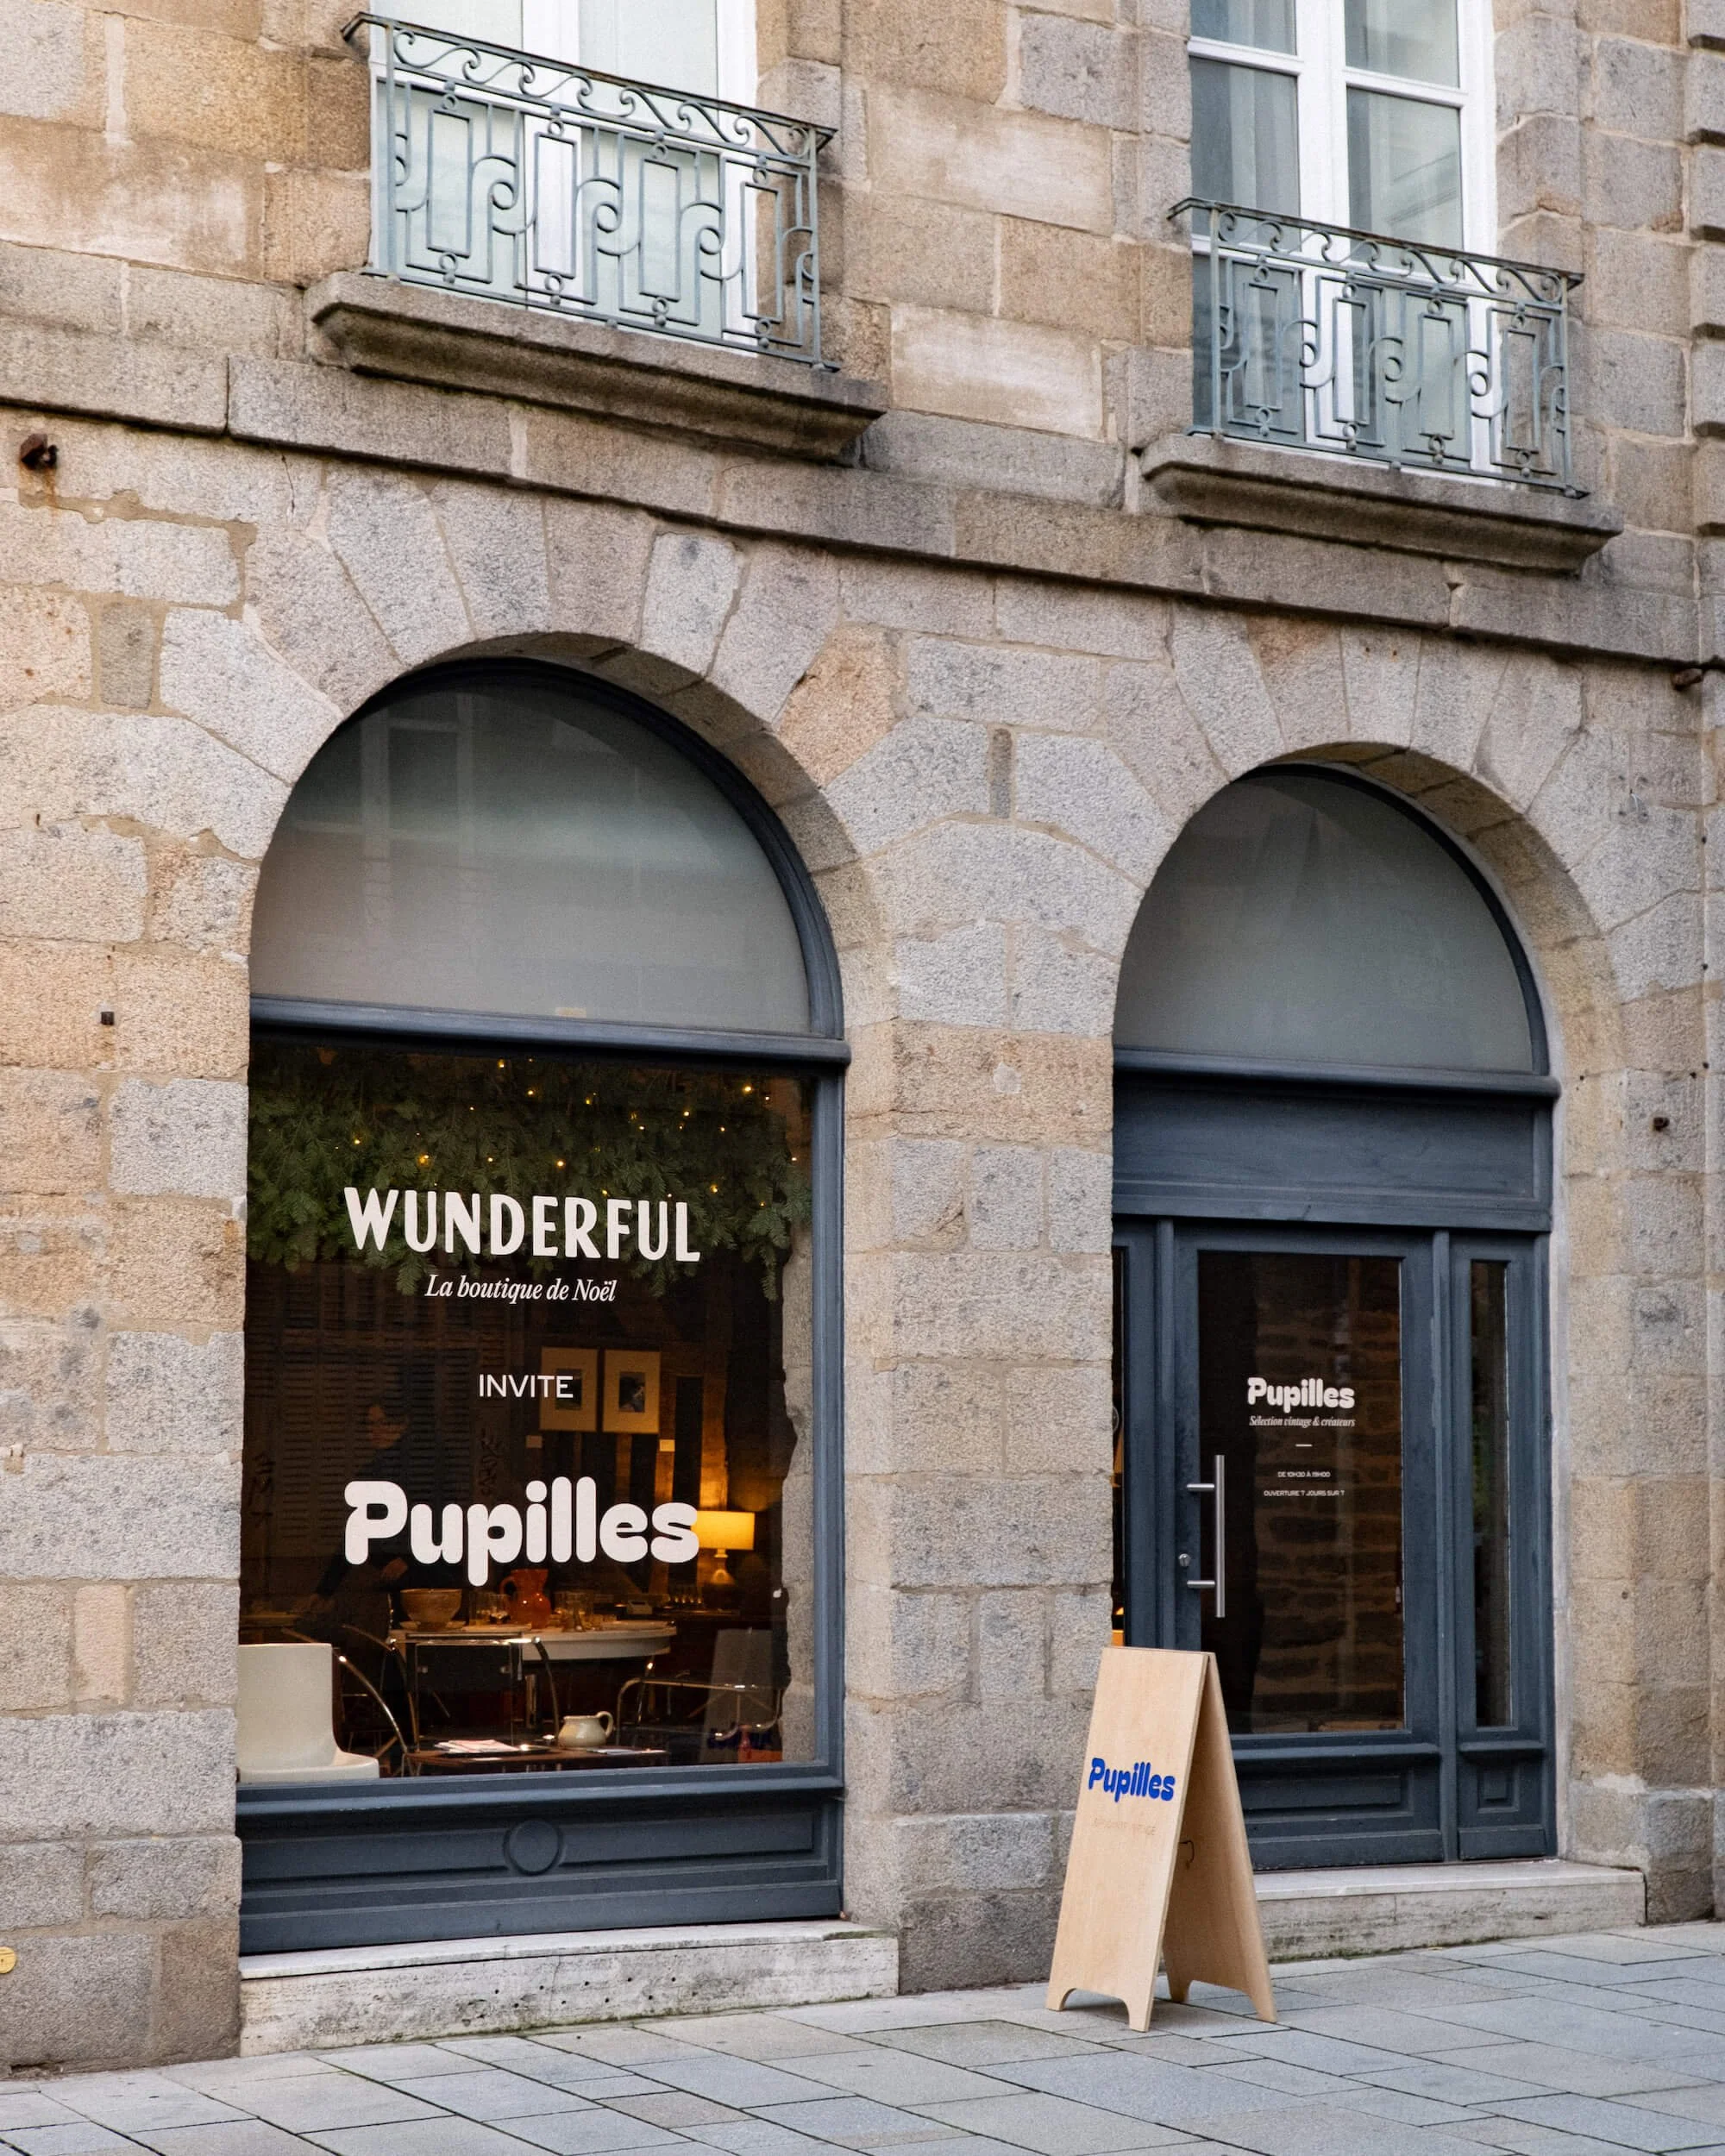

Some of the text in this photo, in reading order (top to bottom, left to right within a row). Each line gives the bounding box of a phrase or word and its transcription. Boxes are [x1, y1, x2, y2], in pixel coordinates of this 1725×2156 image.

[344, 1186, 700, 1262] WUNDERFUL
[424, 1274, 618, 1305] La boutique de Noël
[479, 1374, 574, 1399] INVITE
[1247, 1377, 1355, 1413] Pupilles
[1249, 1415, 1357, 1429] Sélection vintage & créateurs
[344, 1476, 699, 1587] Pupilles
[1088, 1757, 1176, 1802] Pupilles
